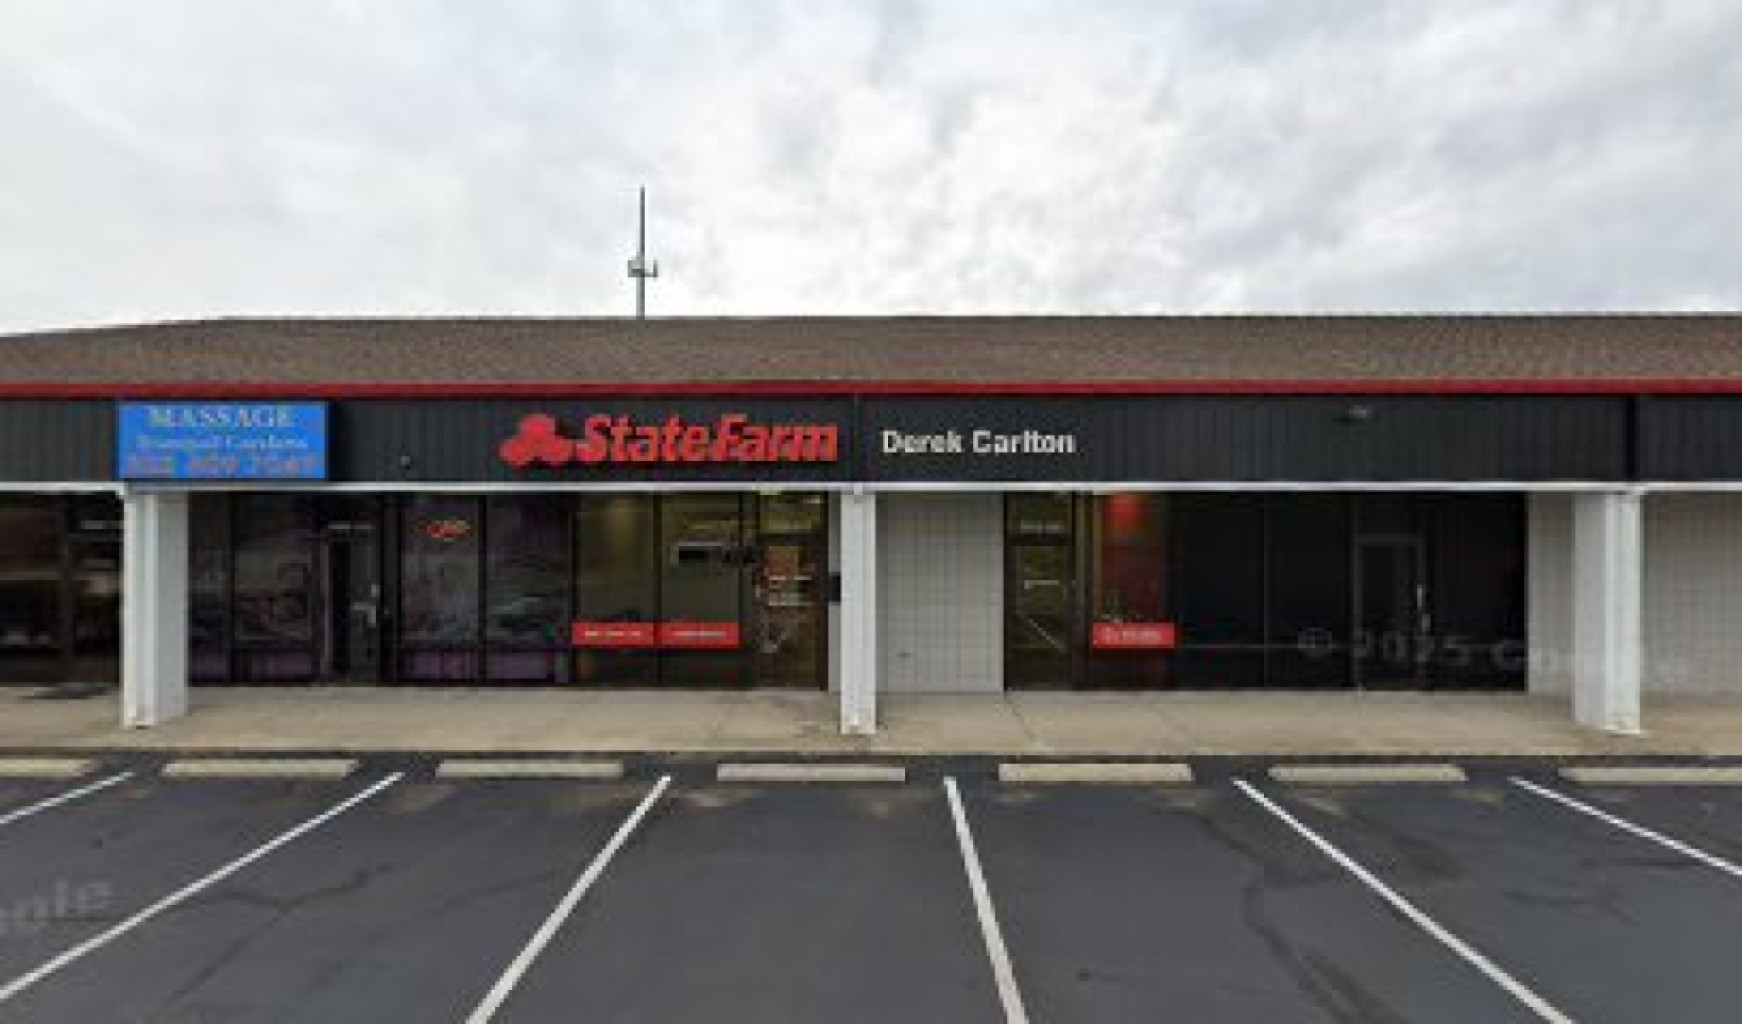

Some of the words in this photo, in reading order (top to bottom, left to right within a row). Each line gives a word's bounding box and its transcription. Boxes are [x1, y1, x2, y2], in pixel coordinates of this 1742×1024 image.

[149, 407, 296, 428] MASSAGE
[882, 430, 962, 453] Derek
[972, 430, 1076, 453] Carlton
